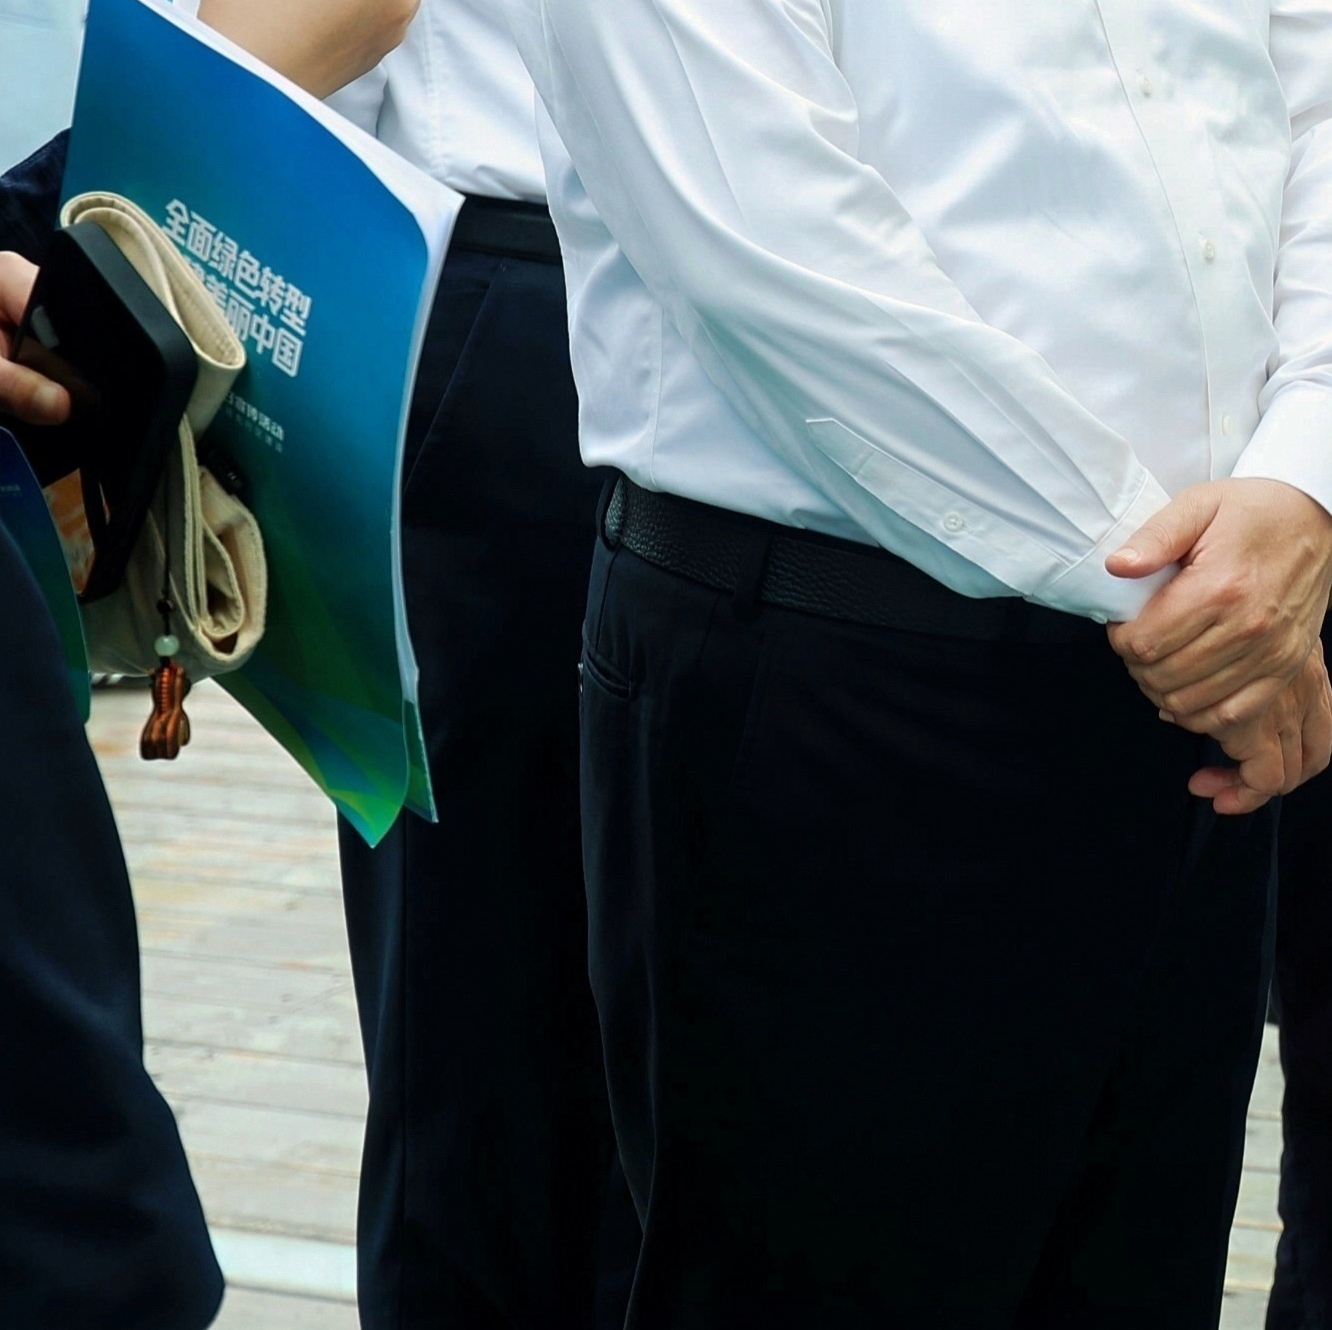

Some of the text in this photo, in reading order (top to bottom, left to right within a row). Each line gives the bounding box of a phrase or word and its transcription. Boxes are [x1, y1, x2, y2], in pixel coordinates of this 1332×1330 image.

[162, 198, 312, 337] 全面绿色转型
[182, 254, 304, 378] 美丽中国
